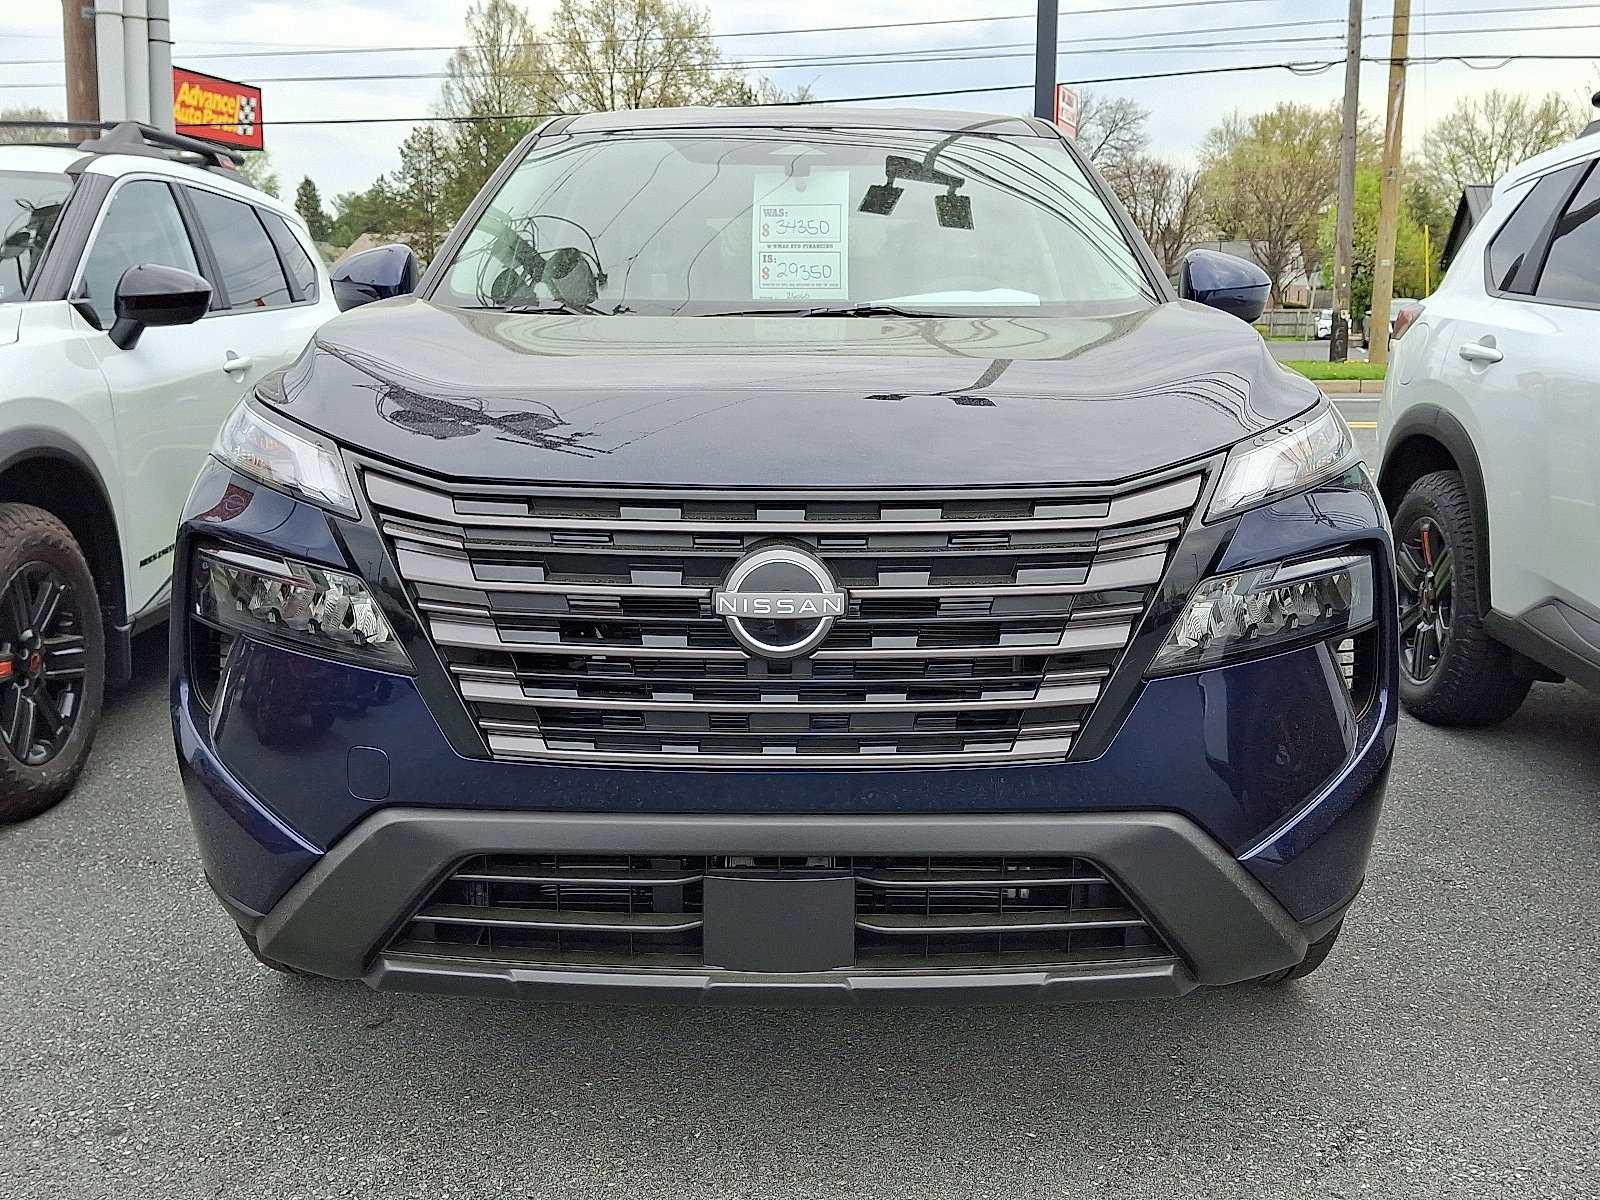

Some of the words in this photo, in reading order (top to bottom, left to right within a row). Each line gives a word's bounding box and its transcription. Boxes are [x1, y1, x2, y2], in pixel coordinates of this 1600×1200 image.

[176, 82, 236, 115] Advance
[174, 103, 203, 125] Auto
[763, 208, 788, 217] WAS:
[776, 219, 830, 235] 34350
[762, 254, 777, 263] IS:
[776, 262, 832, 280] 29350
[719, 597, 841, 614] NISSAN
